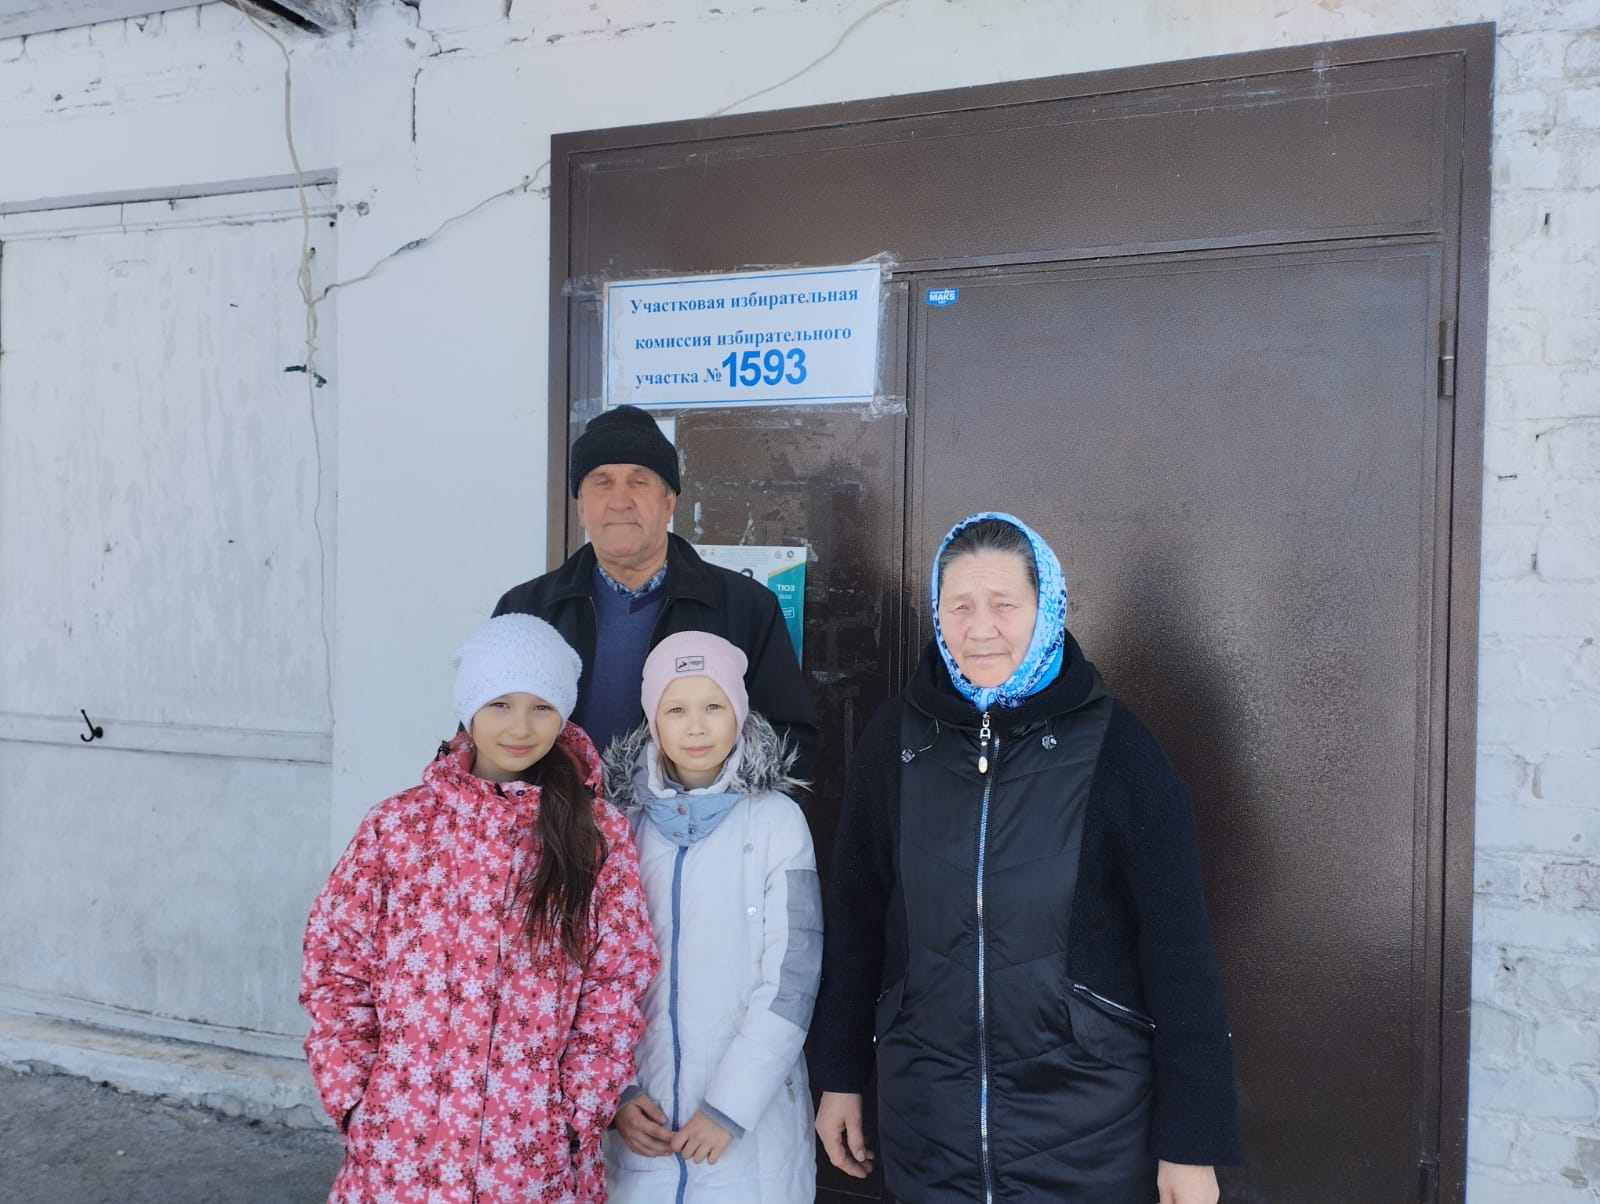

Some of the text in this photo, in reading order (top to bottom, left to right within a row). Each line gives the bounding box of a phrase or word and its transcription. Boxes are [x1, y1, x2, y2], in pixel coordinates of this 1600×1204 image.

[630, 287, 859, 314] Участковая избирательная
[929, 292, 956, 302] MAKS
[634, 325, 852, 350] комиссия избирательного
[634, 373, 699, 390] участка
